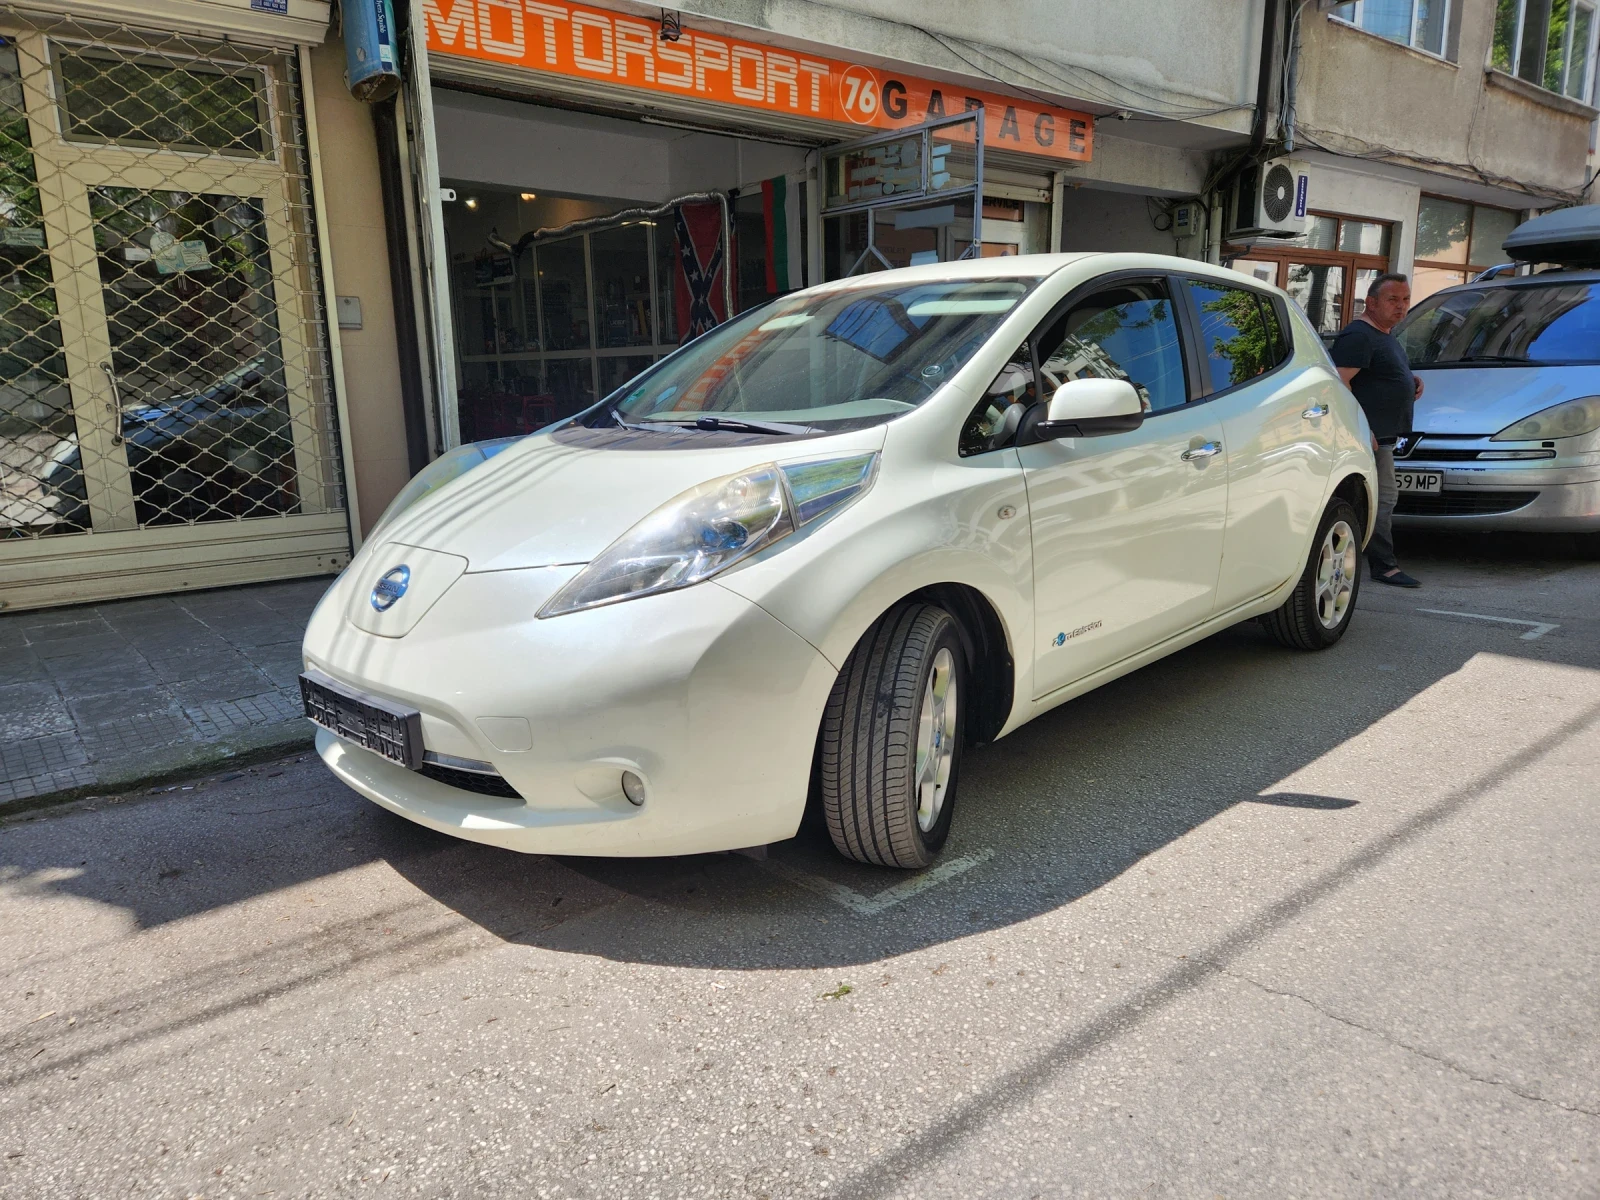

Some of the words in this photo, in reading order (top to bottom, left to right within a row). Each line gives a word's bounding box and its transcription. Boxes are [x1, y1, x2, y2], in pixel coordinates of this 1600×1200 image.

[423, 0, 829, 113] MOTORSPORT
[845, 76, 876, 113] 76
[882, 80, 1086, 153] GARAGE
[983, 197, 1019, 209] ERVICE
[1395, 475, 1412, 489] 59
[1416, 475, 1437, 489] MP
